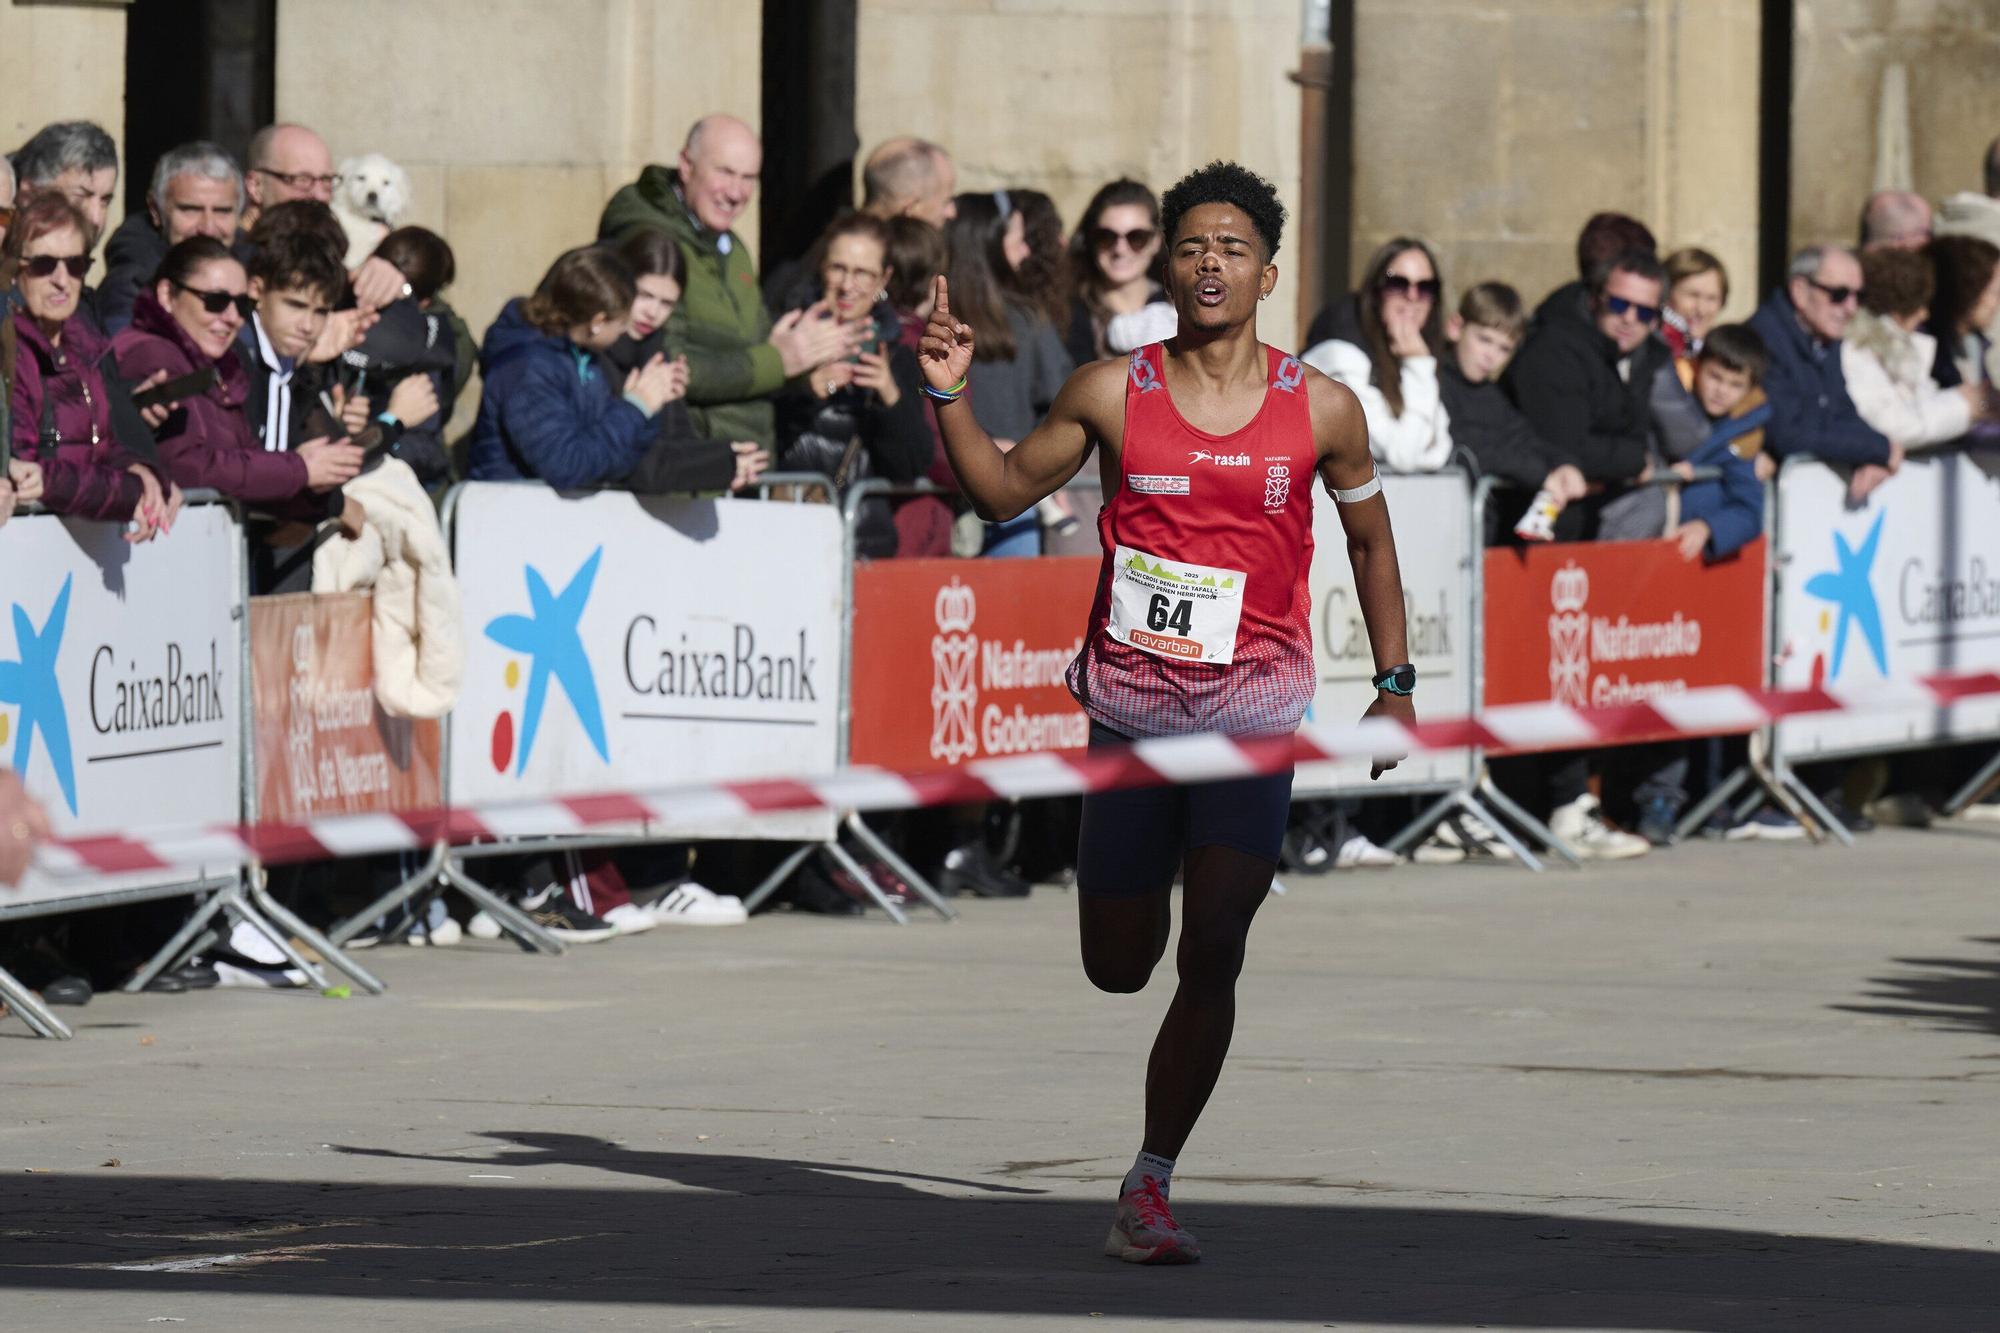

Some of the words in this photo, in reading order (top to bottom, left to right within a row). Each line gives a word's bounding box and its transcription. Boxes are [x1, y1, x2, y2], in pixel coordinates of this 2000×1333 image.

[1214, 452, 1250, 466] rasán
[1125, 574, 1155, 590] TAFALLAKO
[1155, 585, 1176, 595] PEÑEN
[1176, 590, 1196, 598] HERRI
[1142, 574, 1158, 584] CROSS
[1159, 578, 1179, 589] PEÑAS
[1191, 586, 1218, 594] TAFALL
[1146, 593, 1193, 637] 64
[1591, 611, 1701, 662] Nafarroako
[624, 614, 818, 702] CaixaBank
[1133, 631, 1199, 656] navarban
[89, 637, 224, 735] CaixaBank
[982, 703, 1088, 754] Gobernua
